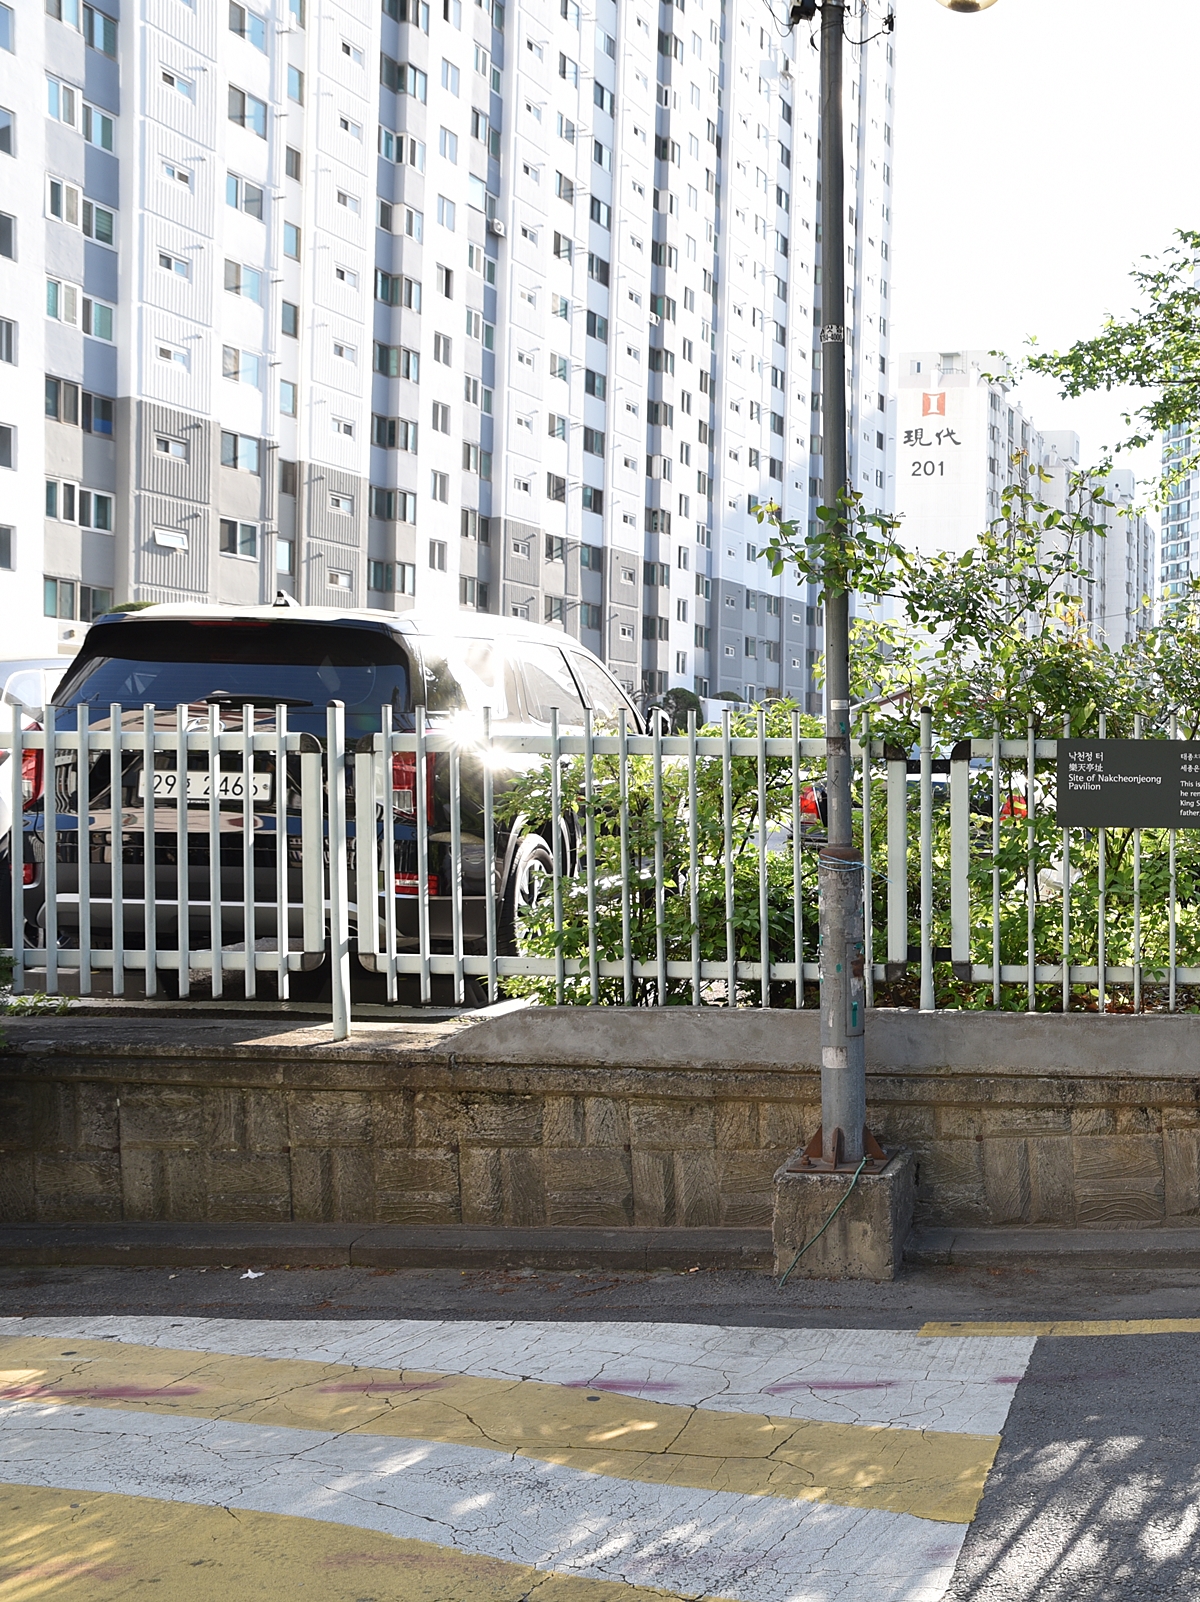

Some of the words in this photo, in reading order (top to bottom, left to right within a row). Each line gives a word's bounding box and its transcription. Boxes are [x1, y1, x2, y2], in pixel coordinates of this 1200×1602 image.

[903, 427, 962, 447] 現代
[911, 460, 944, 477] 201
[1068, 751, 1092, 762] 낙천정
[1095, 751, 1103, 761] 터
[1068, 773, 1085, 782] Site
[1086, 773, 1096, 782] of
[1098, 773, 1162, 785] Nakcheonjeong
[1068, 781, 1101, 790] Pavilion
[1180, 789, 1188, 797] he
[1179, 799, 1194, 807] King
